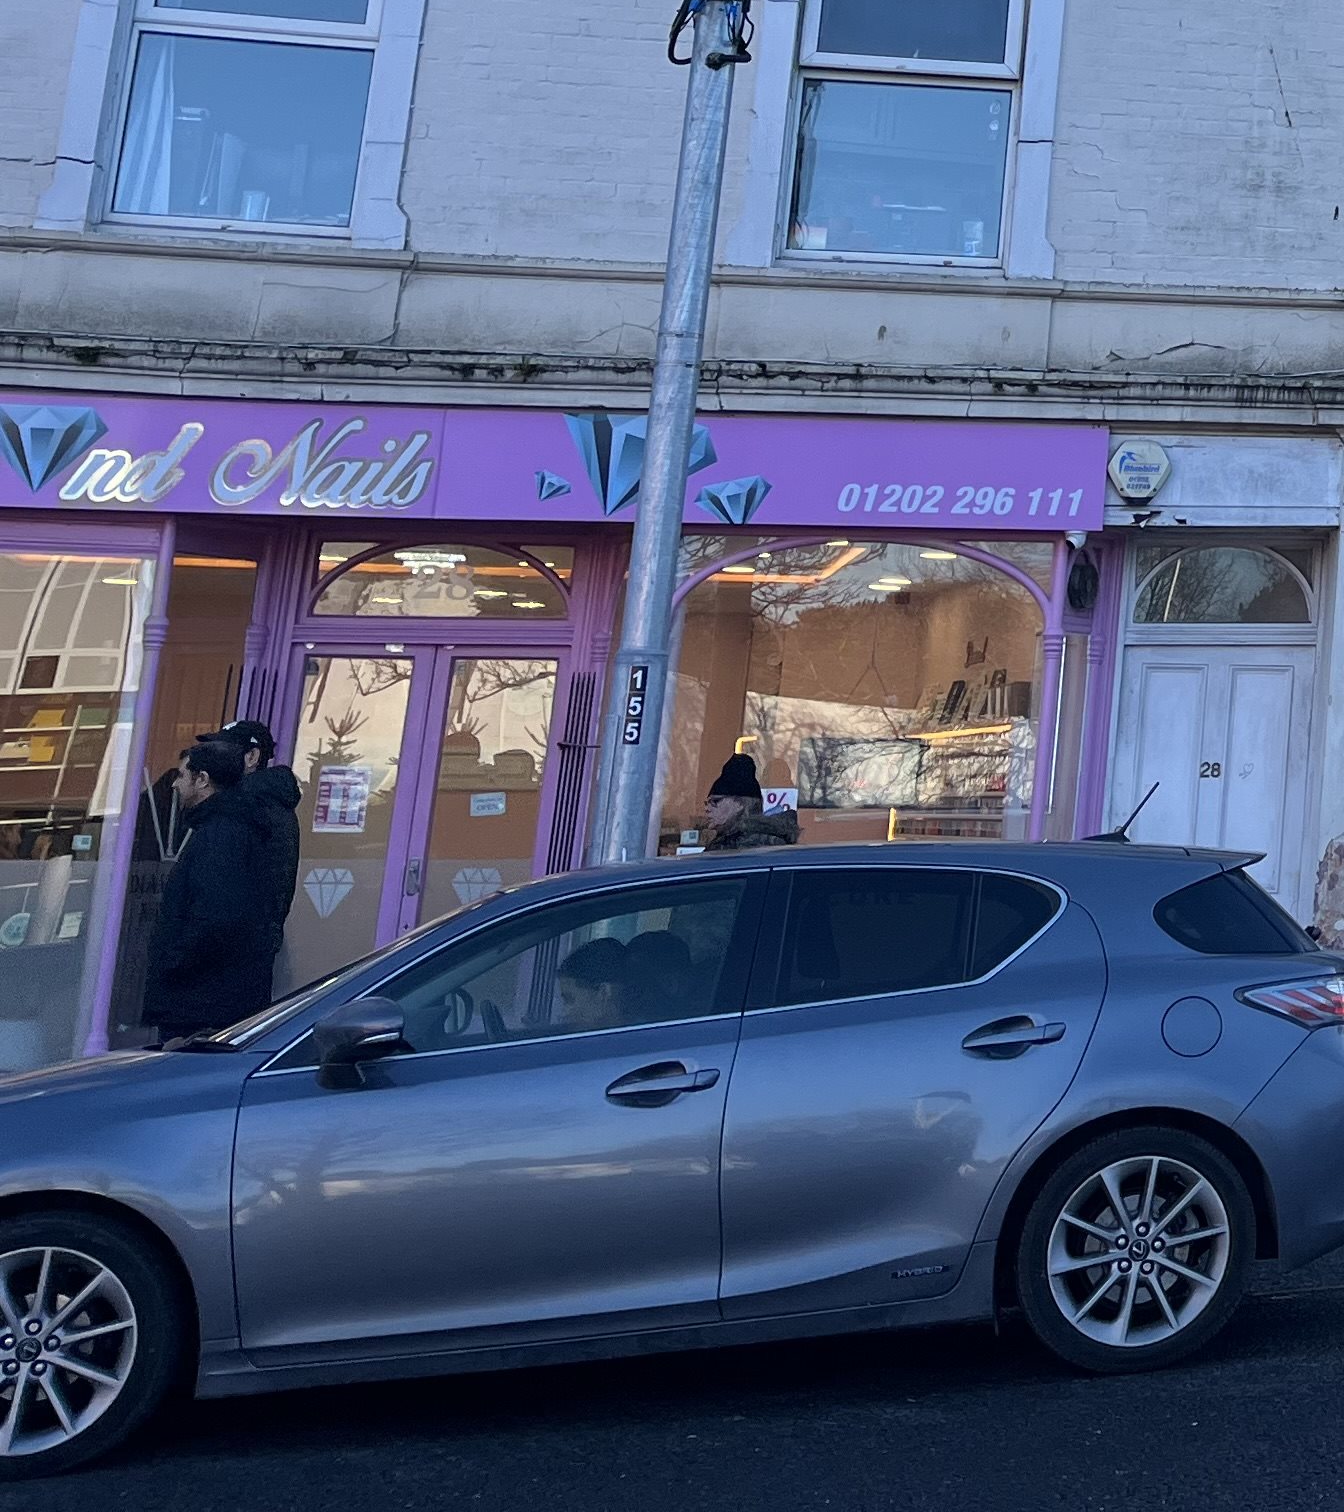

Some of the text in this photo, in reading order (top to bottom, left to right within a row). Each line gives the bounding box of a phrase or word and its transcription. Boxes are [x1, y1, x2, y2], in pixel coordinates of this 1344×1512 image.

[208, 416, 438, 509] Nails
[837, 482, 1085, 518] 01202 296 111
[413, 563, 476, 600] 28
[1200, 762, 1222, 779] 28
